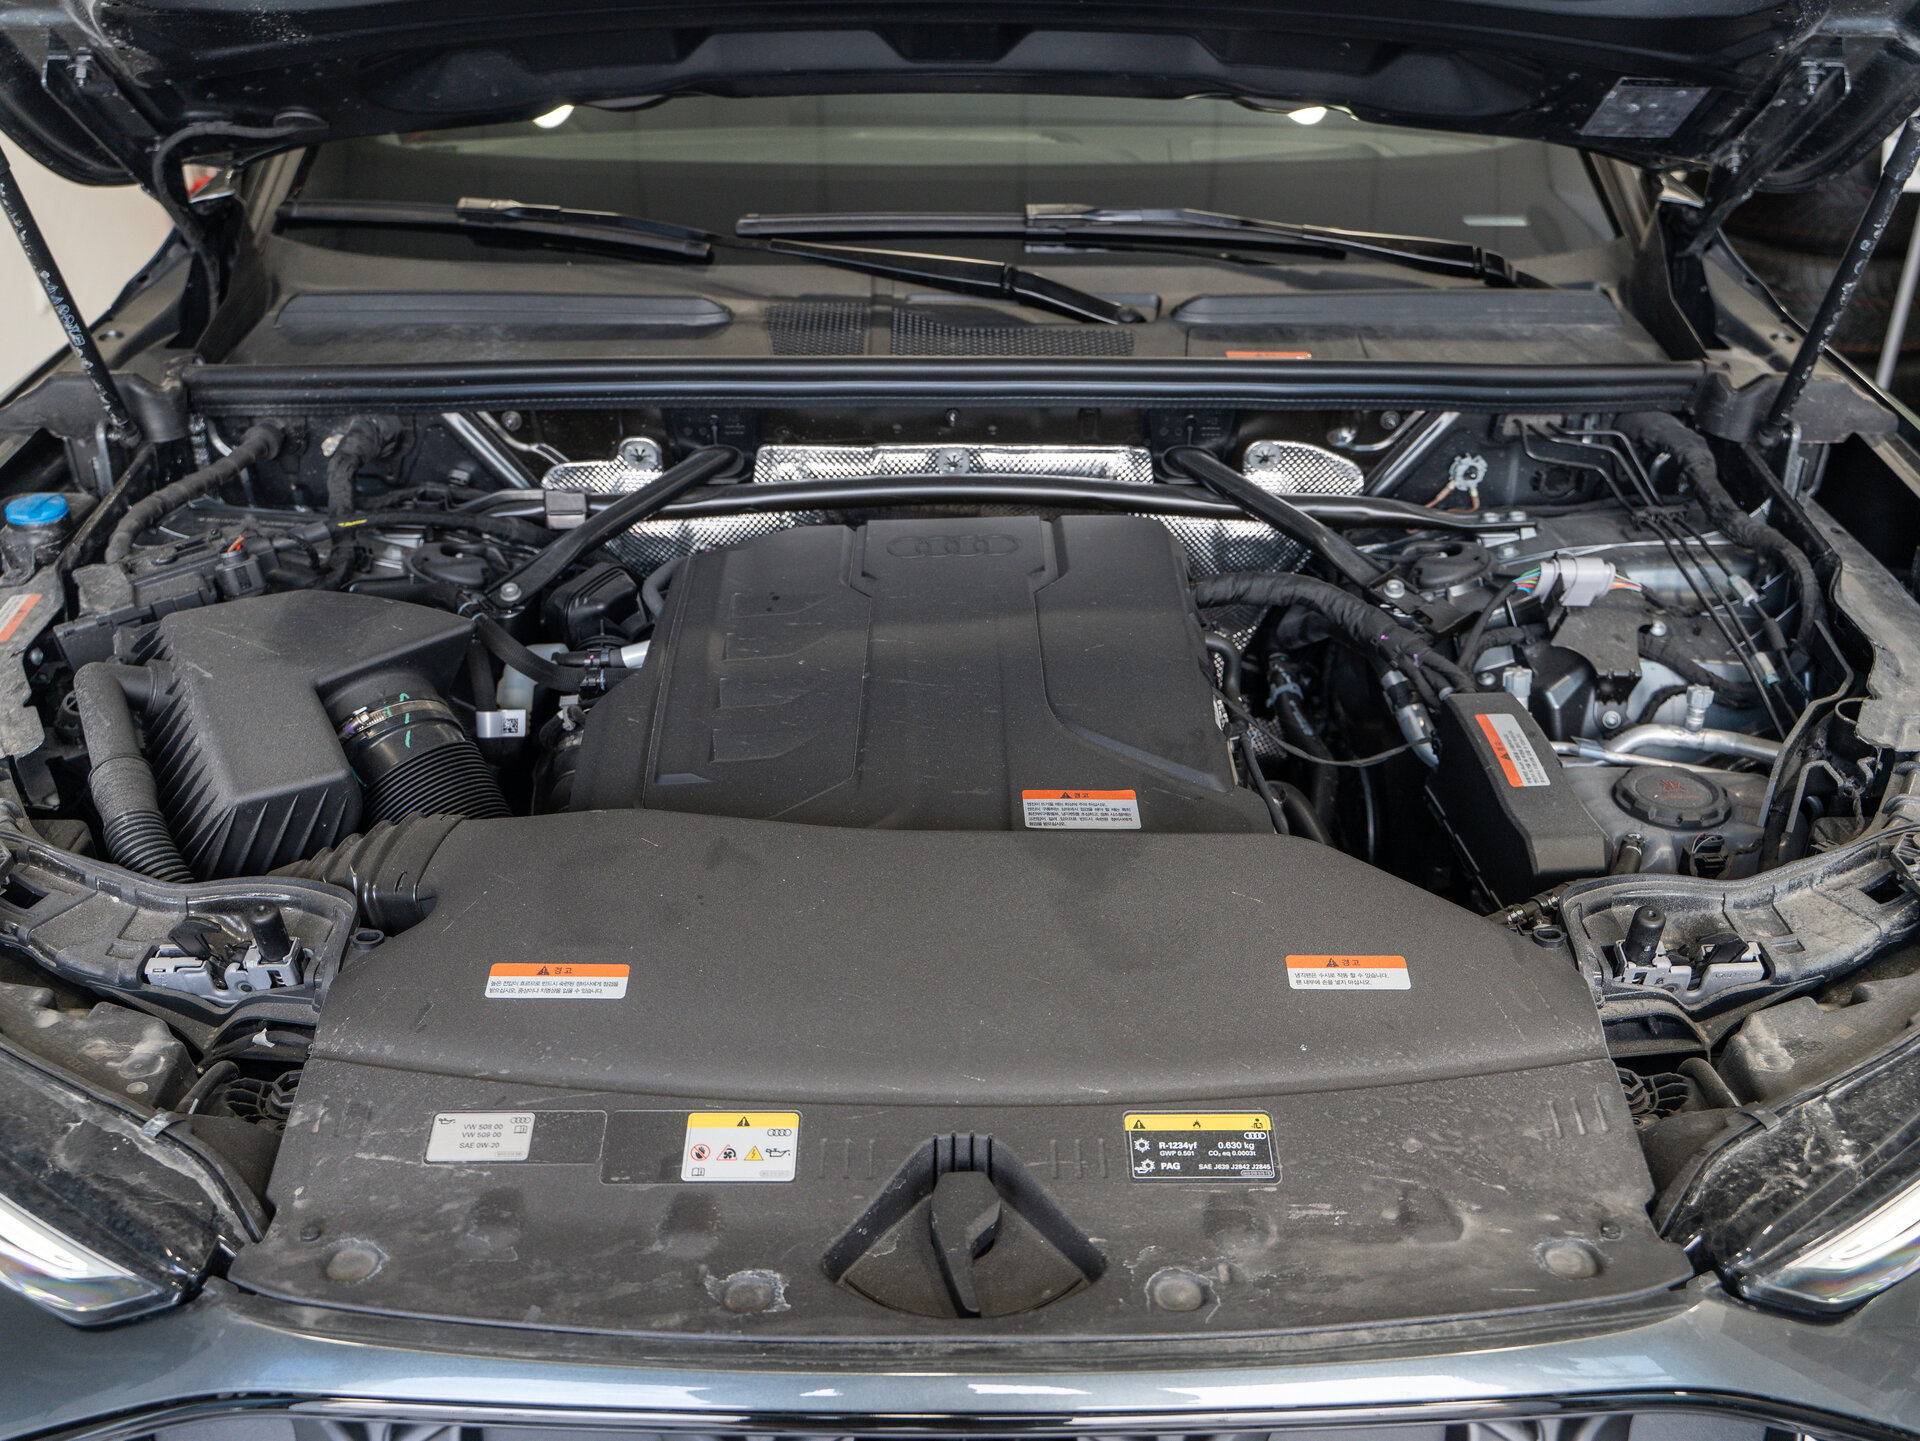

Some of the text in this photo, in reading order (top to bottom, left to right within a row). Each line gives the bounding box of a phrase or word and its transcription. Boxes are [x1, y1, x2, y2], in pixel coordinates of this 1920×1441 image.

[554, 966, 572, 974] 경고
[1158, 1142, 1198, 1150] R-1234yf
[1244, 1142, 1254, 1150] kg
